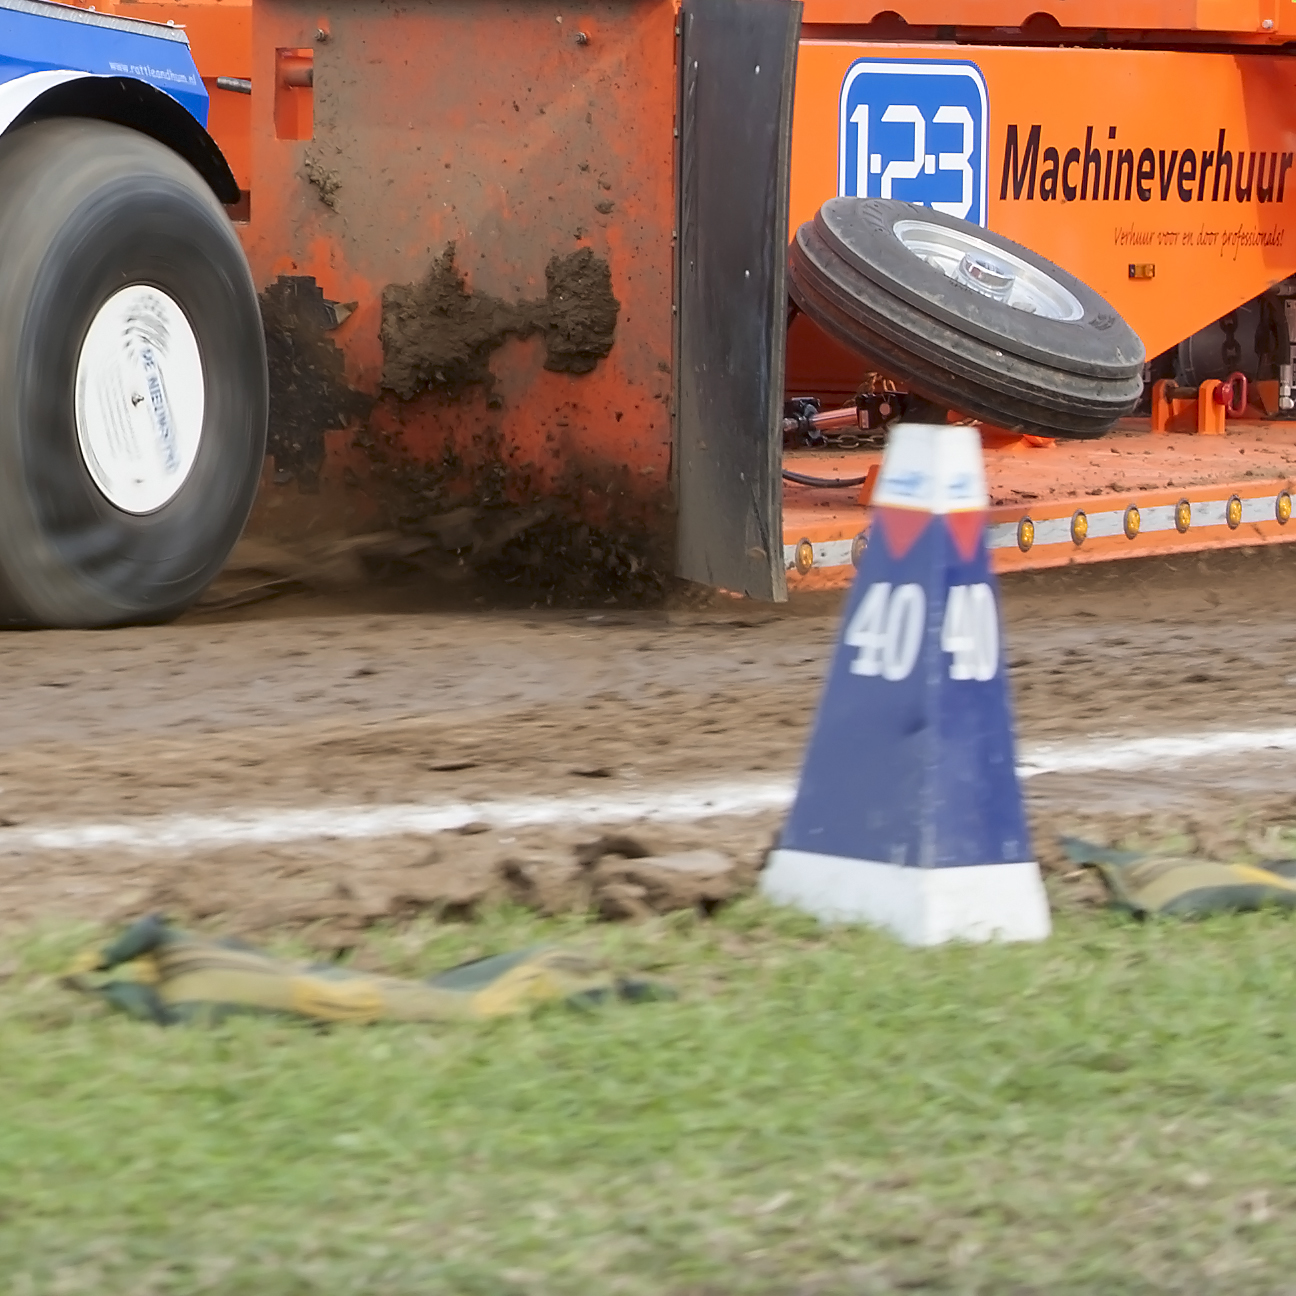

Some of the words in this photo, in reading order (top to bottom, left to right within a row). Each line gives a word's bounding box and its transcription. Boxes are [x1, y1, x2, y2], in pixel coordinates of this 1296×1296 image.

[999, 124, 1293, 204] Machineverhuur
[1114, 222, 1155, 246] Verhuur
[1157, 231, 1180, 246] voor
[1182, 231, 1194, 246] en
[1196, 223, 1219, 246] door
[1220, 223, 1285, 261] professionals!
[845, 582, 926, 682] 40
[941, 582, 1000, 682] 40
